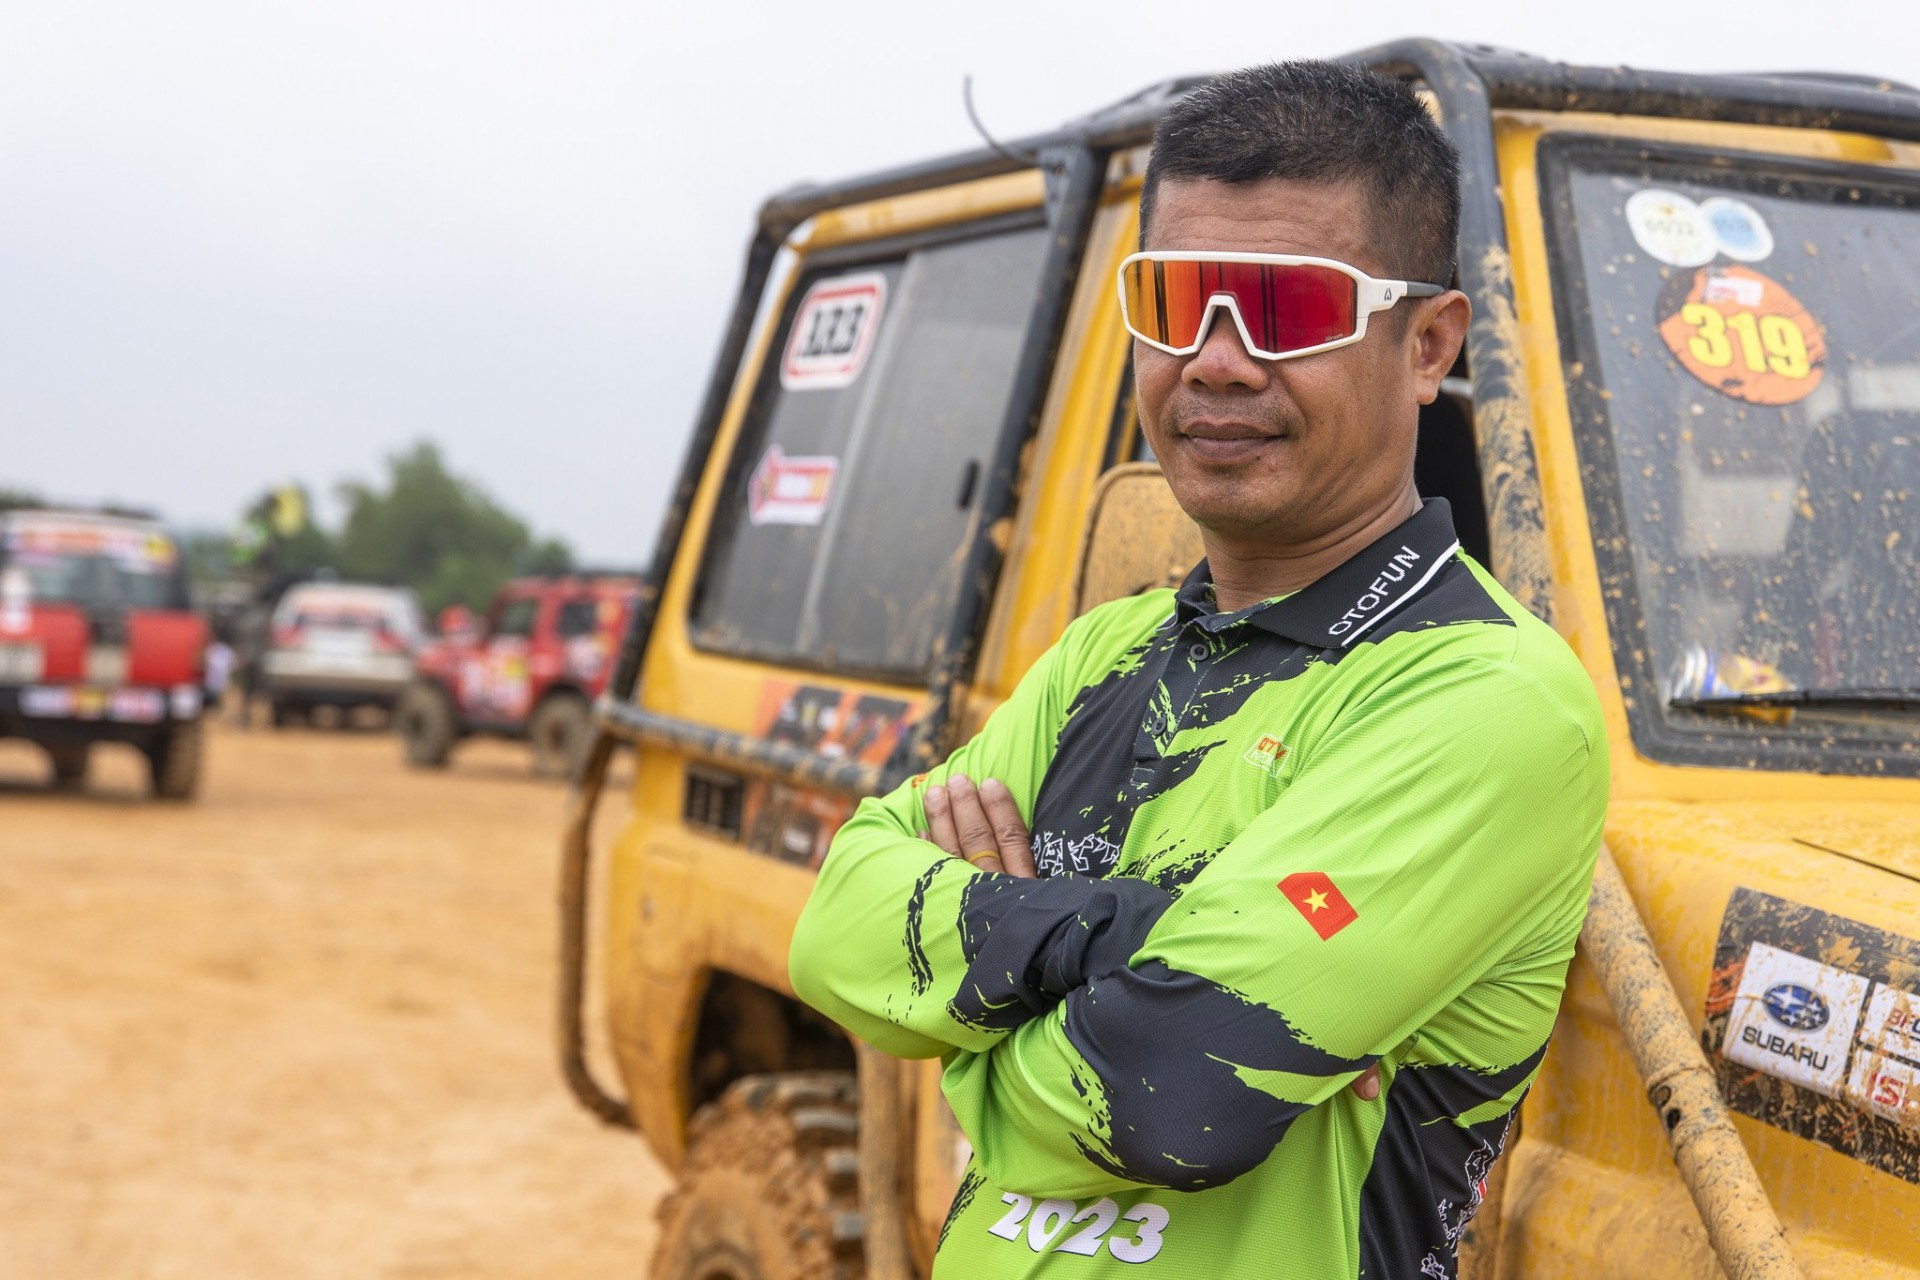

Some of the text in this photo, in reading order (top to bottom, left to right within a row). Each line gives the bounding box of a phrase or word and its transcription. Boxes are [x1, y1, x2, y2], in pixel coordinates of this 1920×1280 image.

[1681, 303, 1811, 379] 319
[1328, 545, 1420, 635] OTOFUN
[1742, 1026, 1828, 1071] SUBARU
[987, 1191, 1170, 1264] 2023
